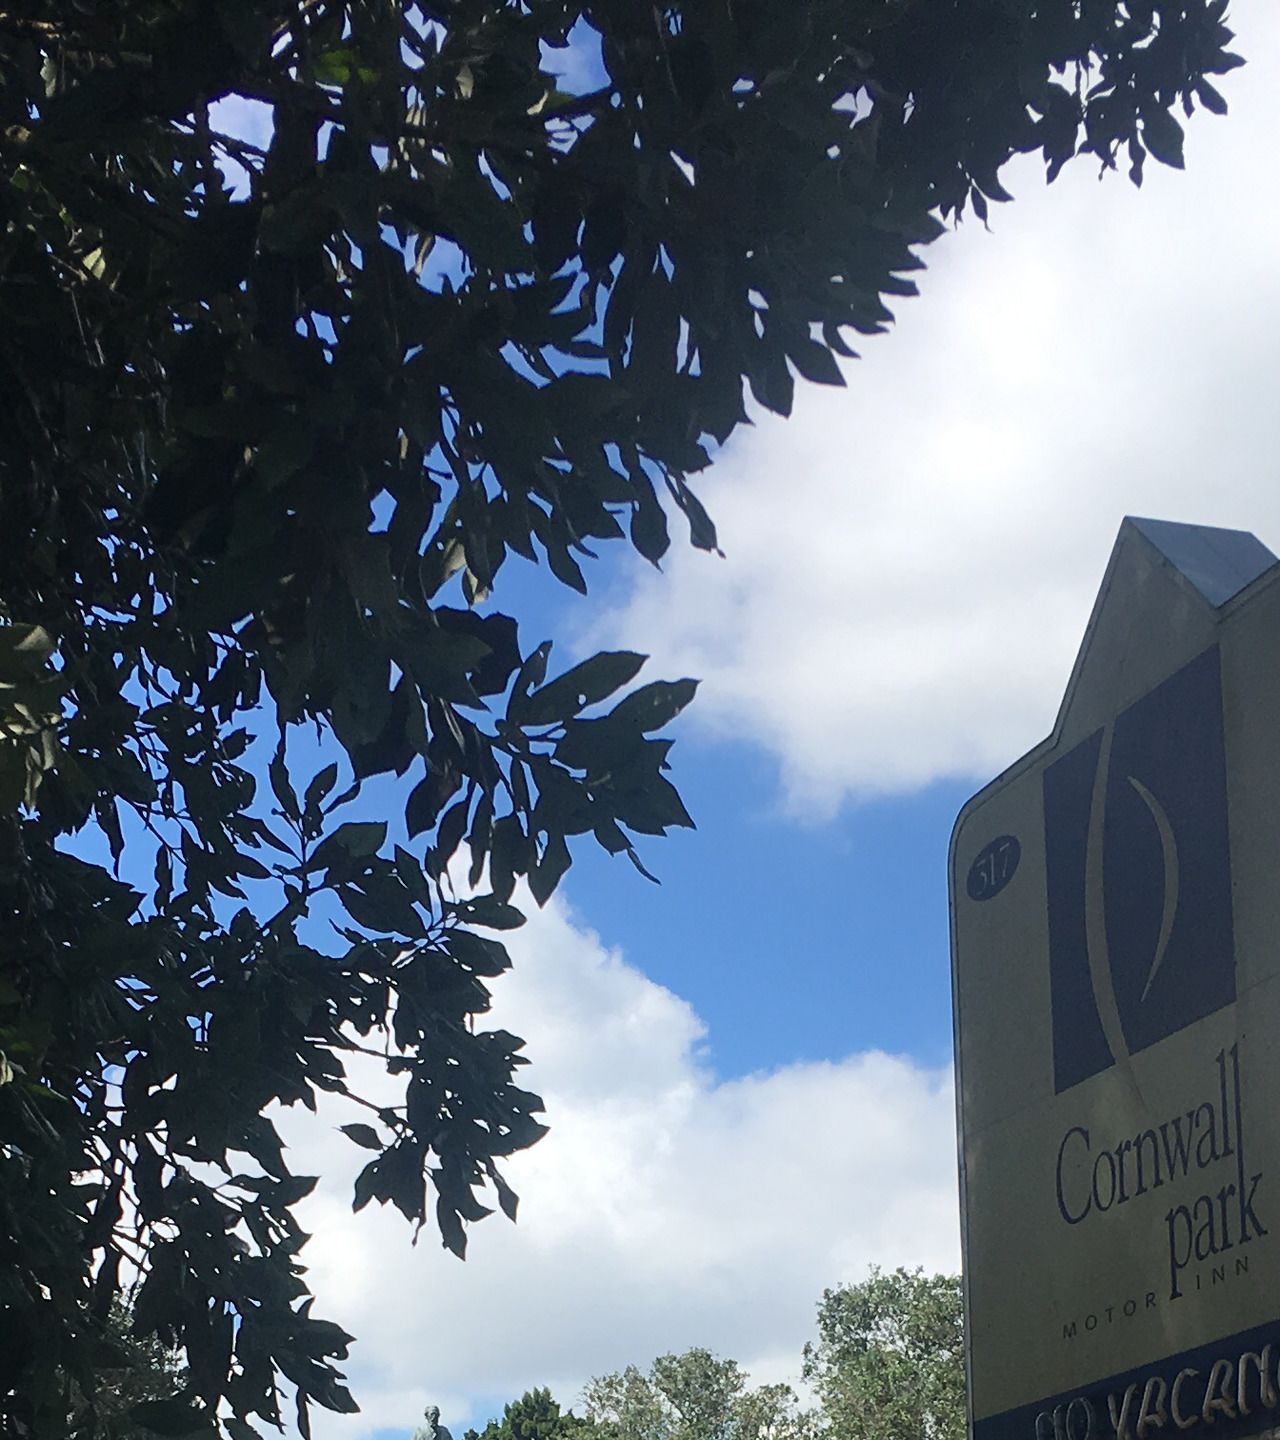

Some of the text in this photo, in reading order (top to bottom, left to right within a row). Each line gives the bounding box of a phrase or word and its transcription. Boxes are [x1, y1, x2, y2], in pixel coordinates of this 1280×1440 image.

[1055, 1039, 1244, 1225] Cornwall
[1062, 1255, 1249, 1340] MOTOR INN
[1165, 1172, 1268, 1301] park
